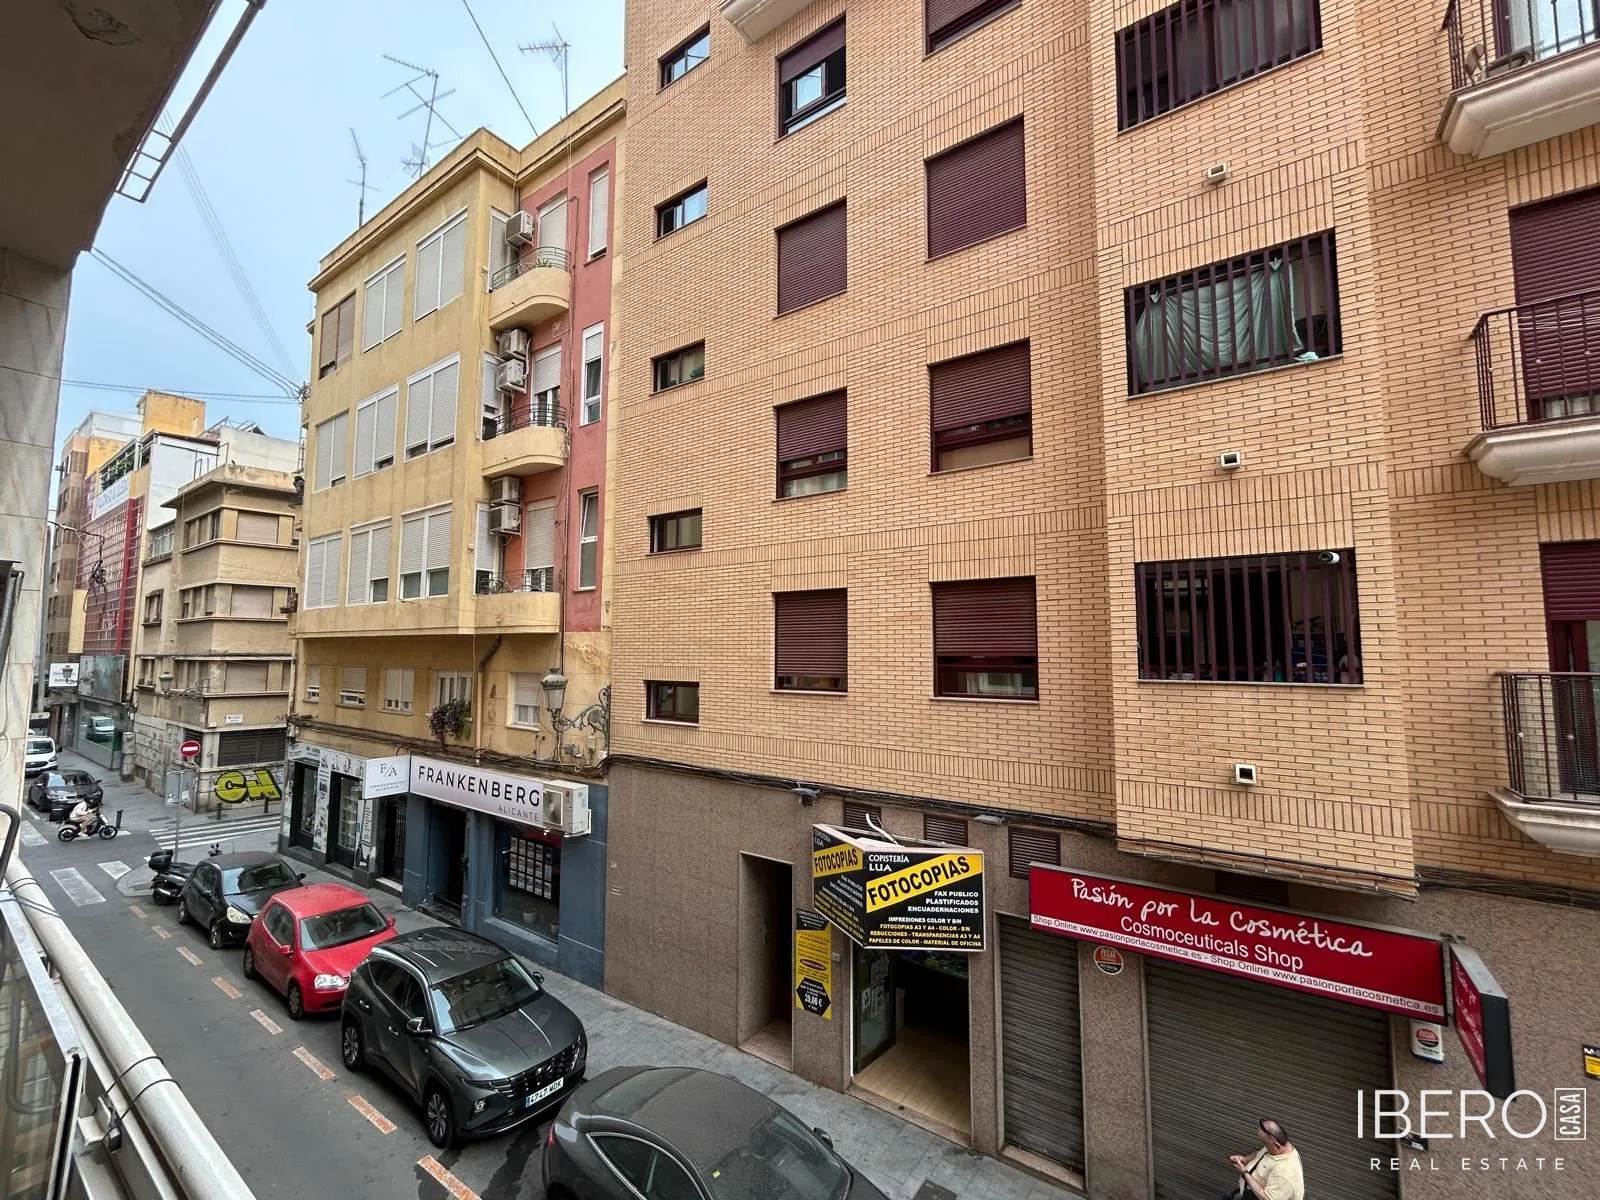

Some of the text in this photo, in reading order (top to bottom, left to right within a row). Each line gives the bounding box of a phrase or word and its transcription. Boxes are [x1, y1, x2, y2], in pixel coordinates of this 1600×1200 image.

[418, 765, 540, 807] FRANKENBERG
[498, 804, 539, 822] ALICANTE
[814, 848, 858, 873] FOTOCOPIAS
[867, 856, 970, 906] FOTOCOPIAS
[869, 863, 892, 872] LUA
[926, 898, 979, 906] PLASTIFICADOS
[1071, 878, 1134, 909] Pasión
[1140, 900, 1179, 921] por
[1229, 910, 1373, 958] Cosmética
[1033, 914, 1053, 926] Shop
[1054, 918, 1078, 932] Online
[1079, 926, 1202, 960] www.pasionporlacosmetica.es
[1210, 954, 1235, 968] Shop
[1238, 961, 1270, 976] Online
[1272, 970, 1439, 1014] www.pasionporlacosmetica.es
[1120, 916, 1304, 972] Cosmoceuticals Shop
